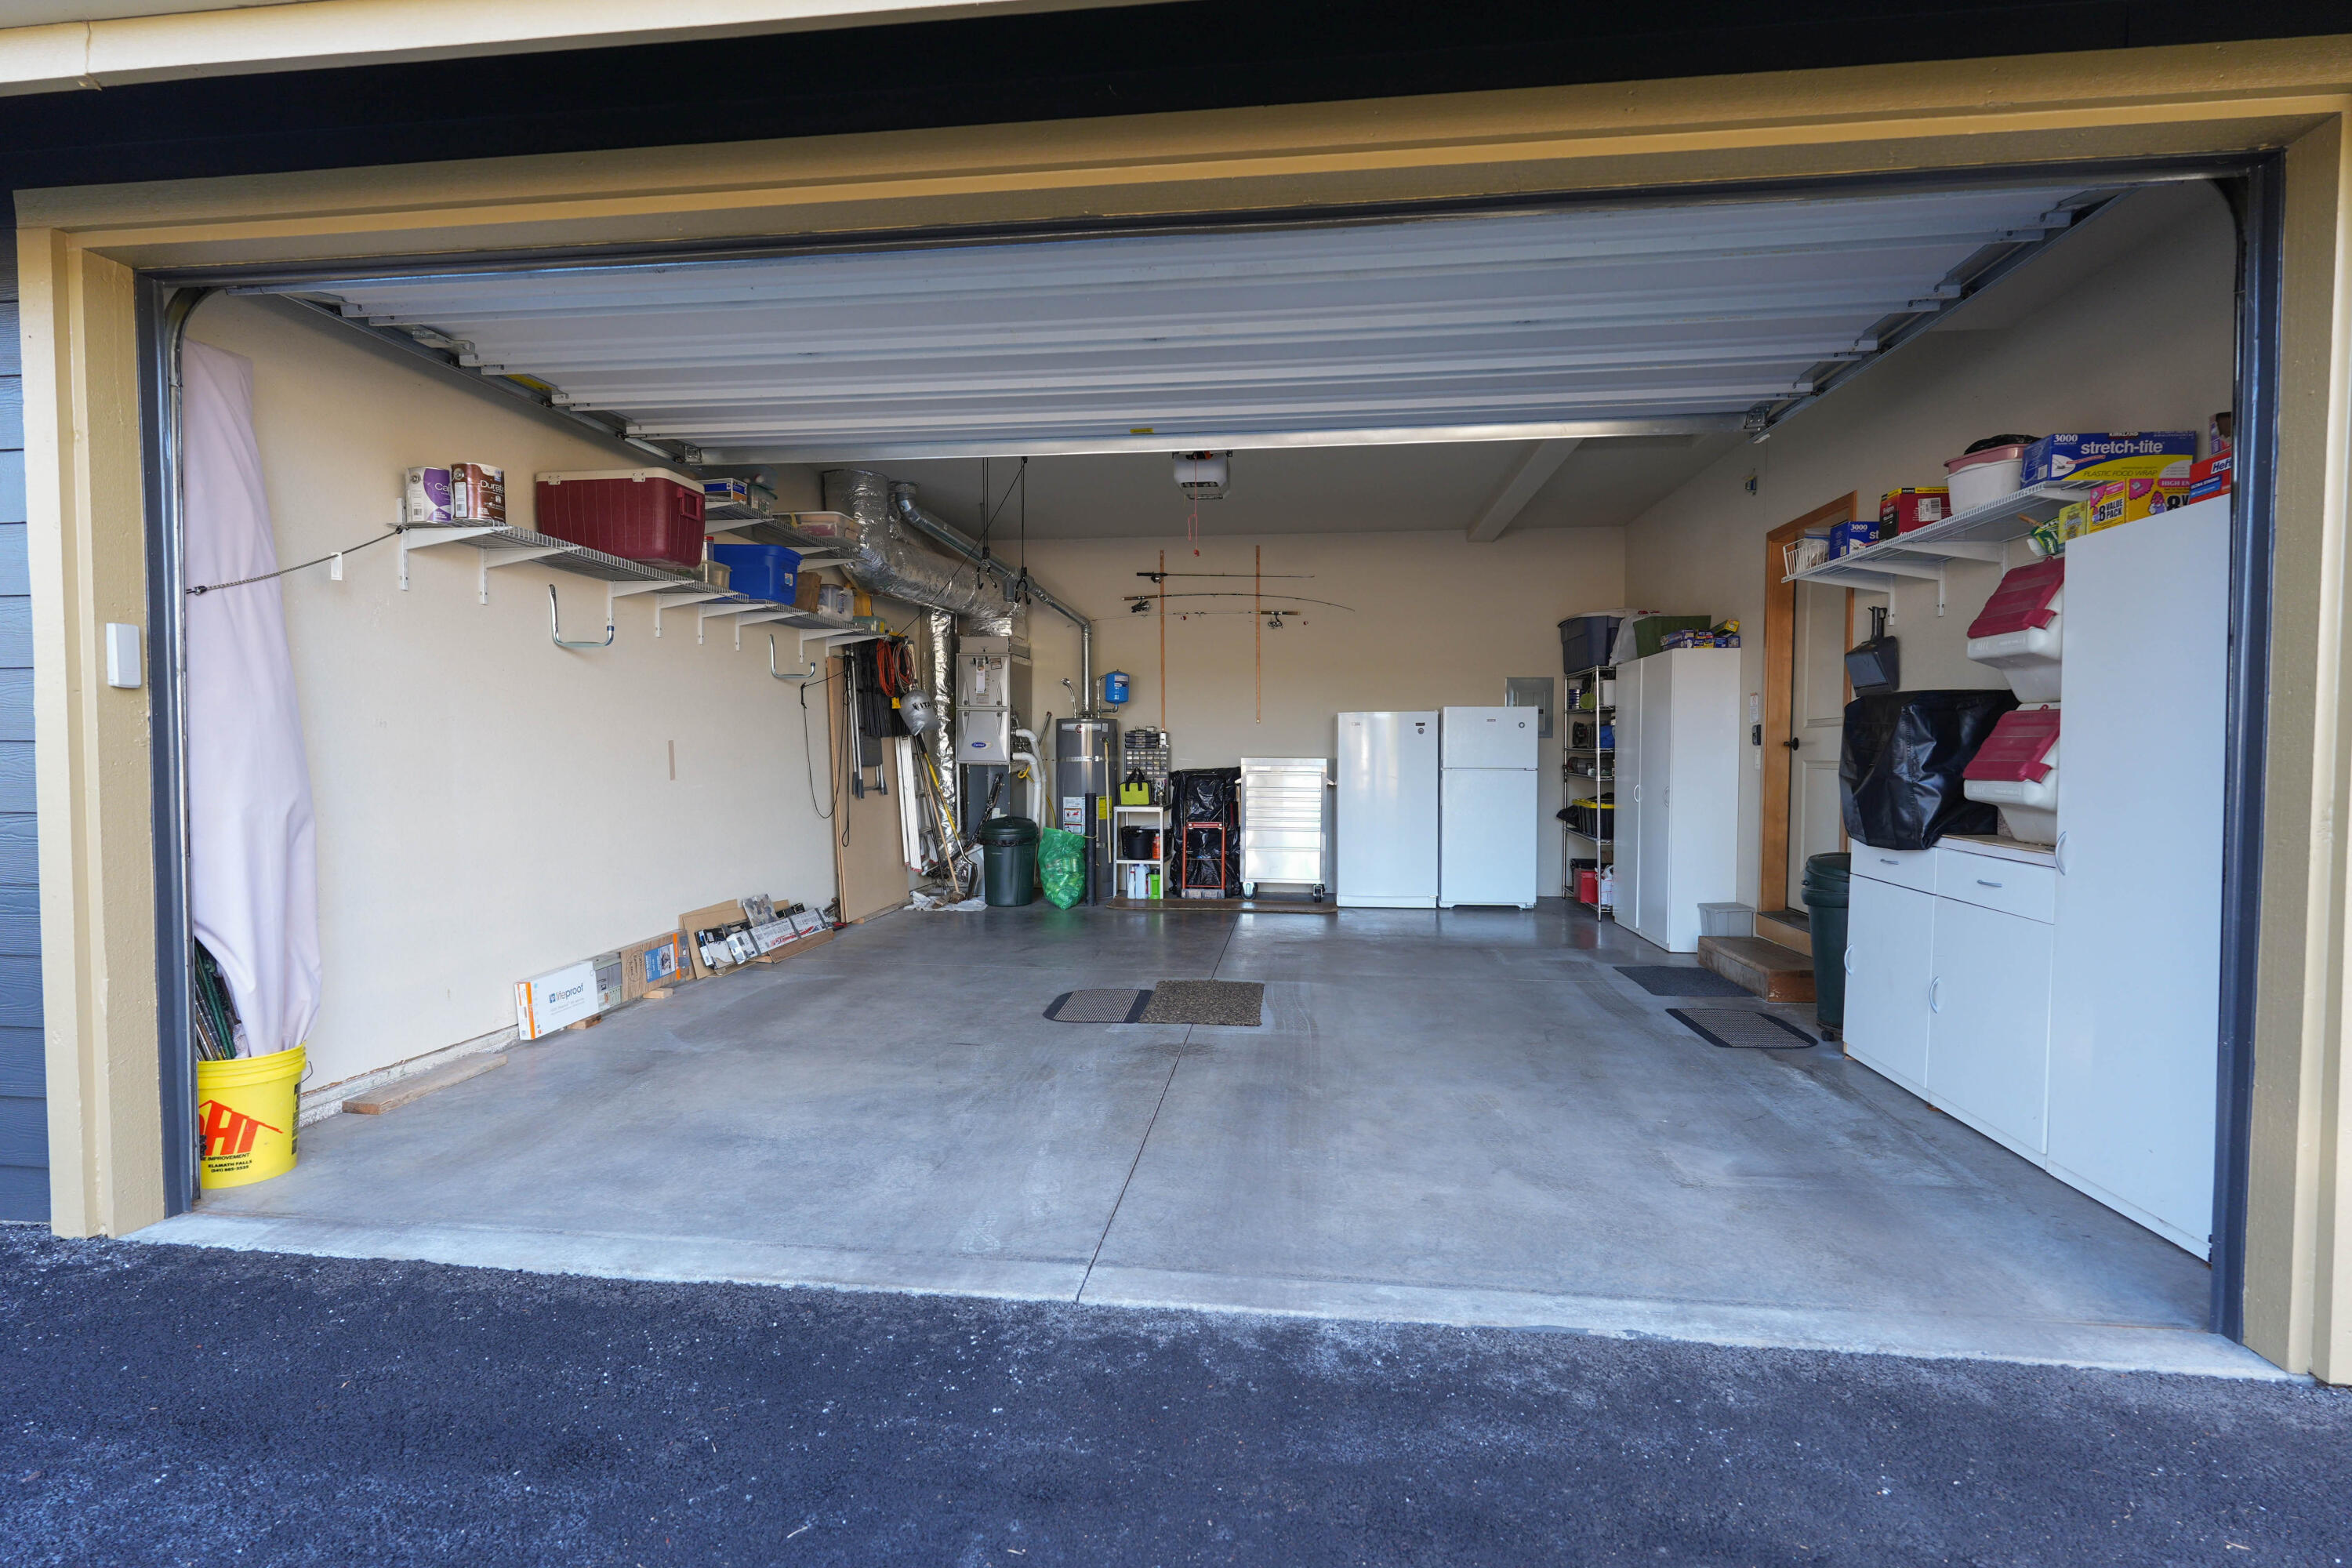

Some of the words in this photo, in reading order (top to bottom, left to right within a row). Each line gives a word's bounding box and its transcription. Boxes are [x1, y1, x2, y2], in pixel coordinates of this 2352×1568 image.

[2053, 434, 2078, 443] 3000
[2080, 440, 2164, 455] stretch-tite
[2106, 499, 2123, 510] VALUE
[2099, 505, 2106, 521] 8
[2106, 506, 2122, 519] PACK
[557, 982, 584, 1002] lifeproof
[207, 1152, 250, 1161] IMPROVEMENT
